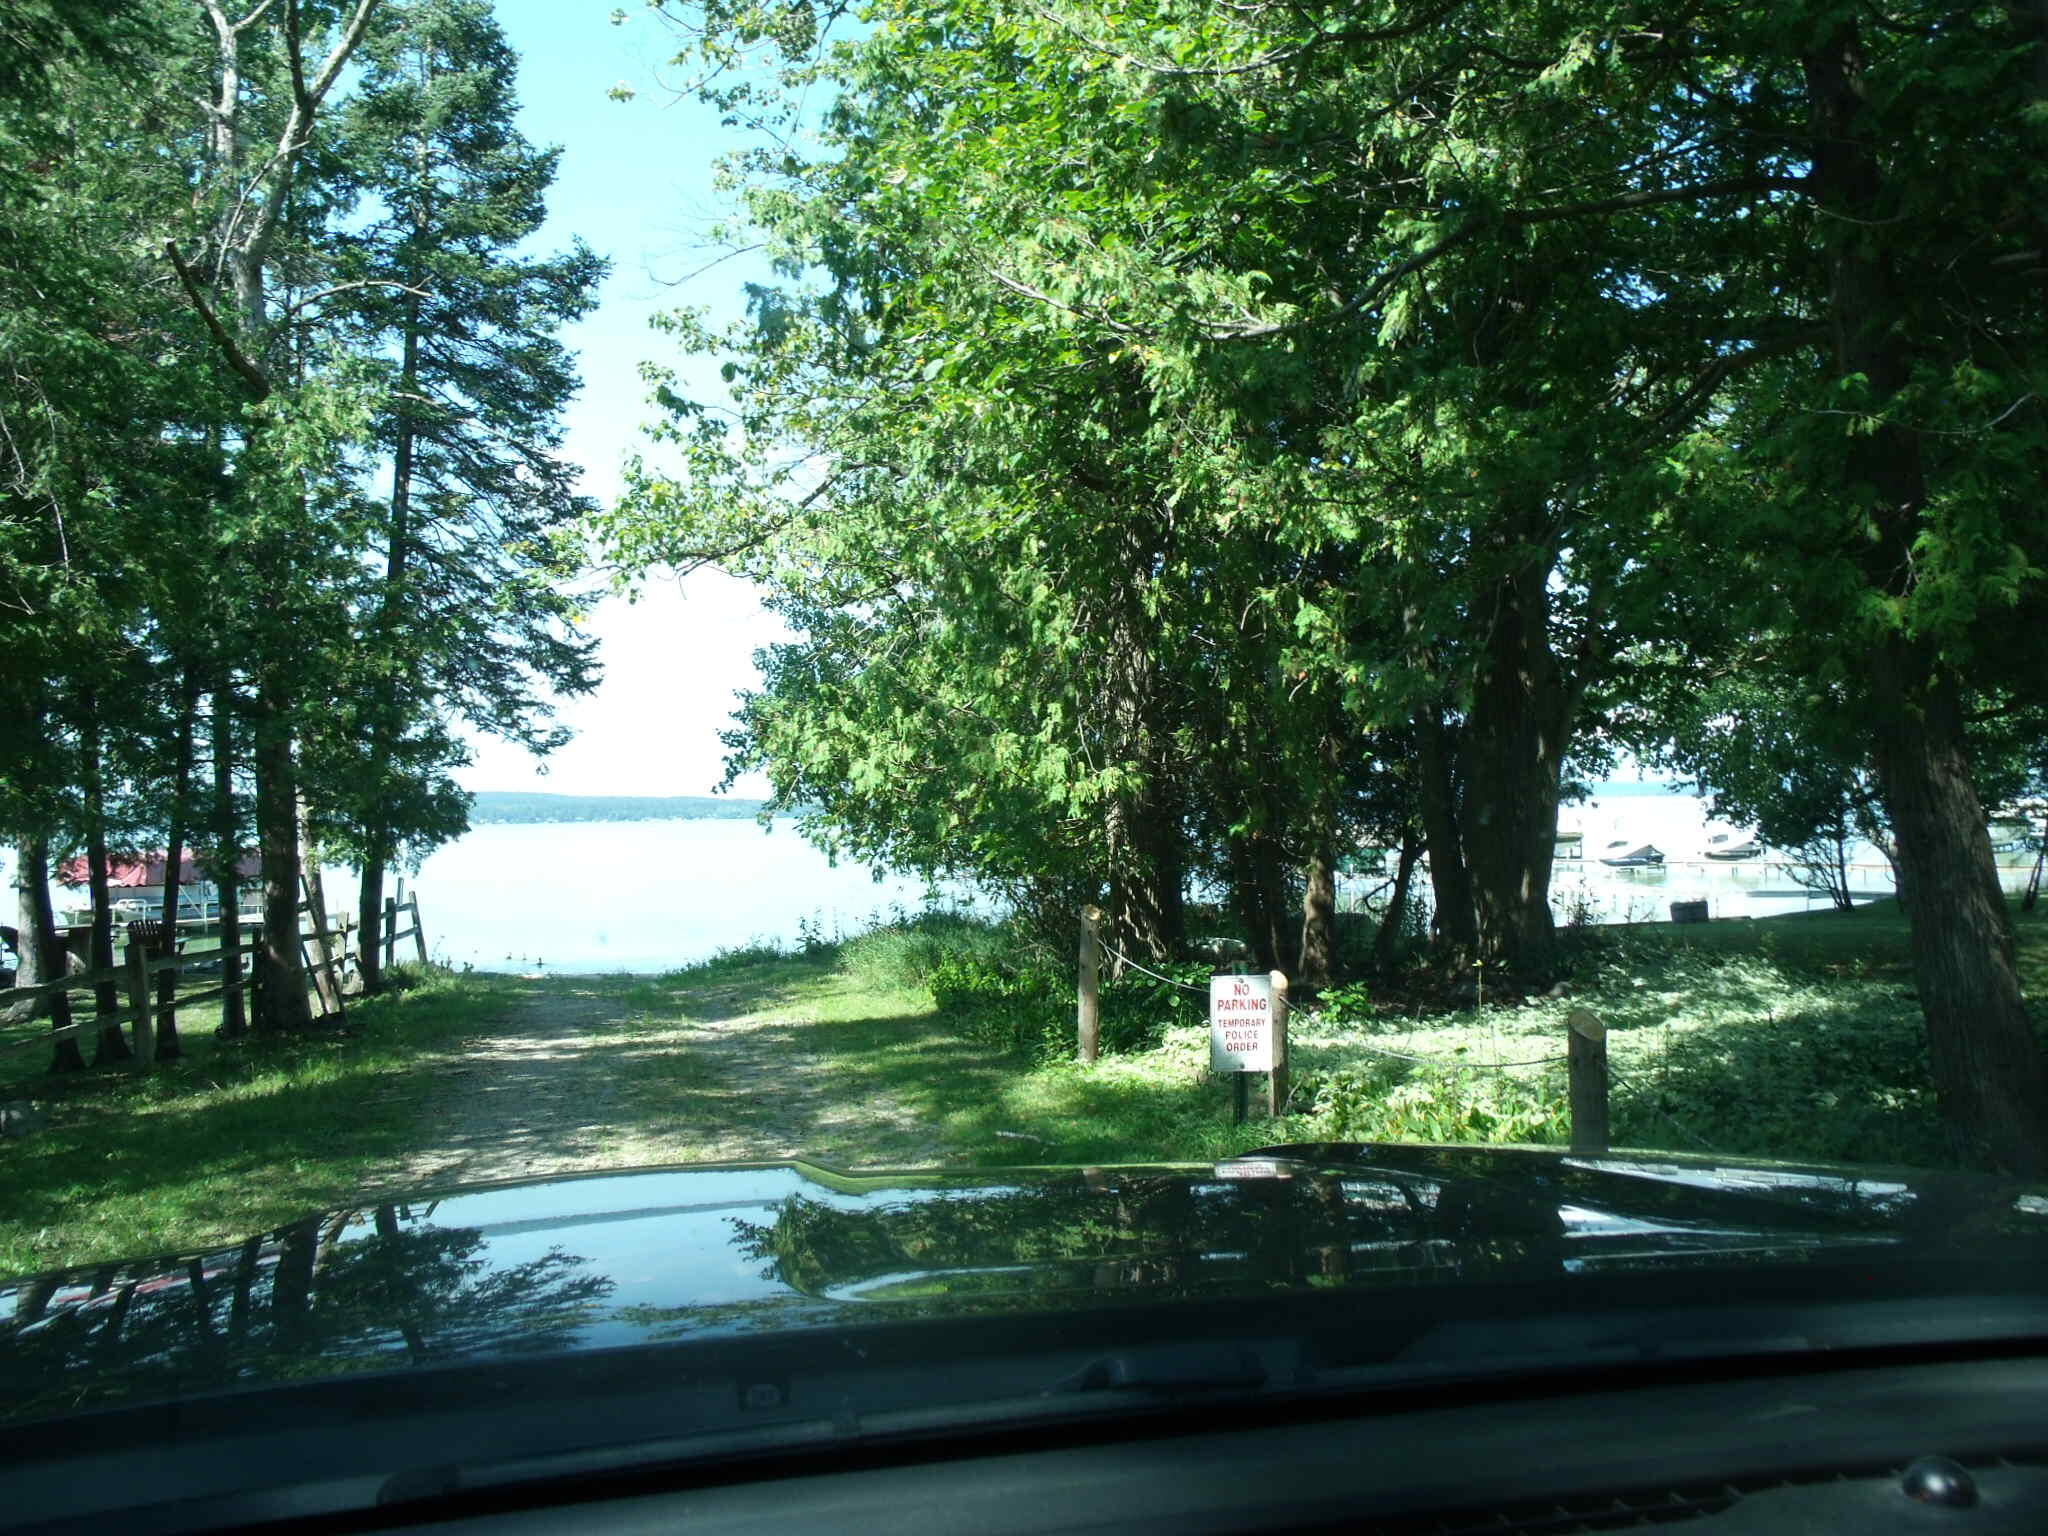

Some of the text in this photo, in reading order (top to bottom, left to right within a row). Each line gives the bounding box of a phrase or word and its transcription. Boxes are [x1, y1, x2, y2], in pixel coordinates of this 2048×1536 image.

[1234, 984, 1250, 996] NO
[1217, 998, 1267, 1011] PARKING
[1218, 1019, 1266, 1028] TEMPORARY
[1225, 1031, 1259, 1040] POLICE
[1226, 1043, 1258, 1052] ORDER
